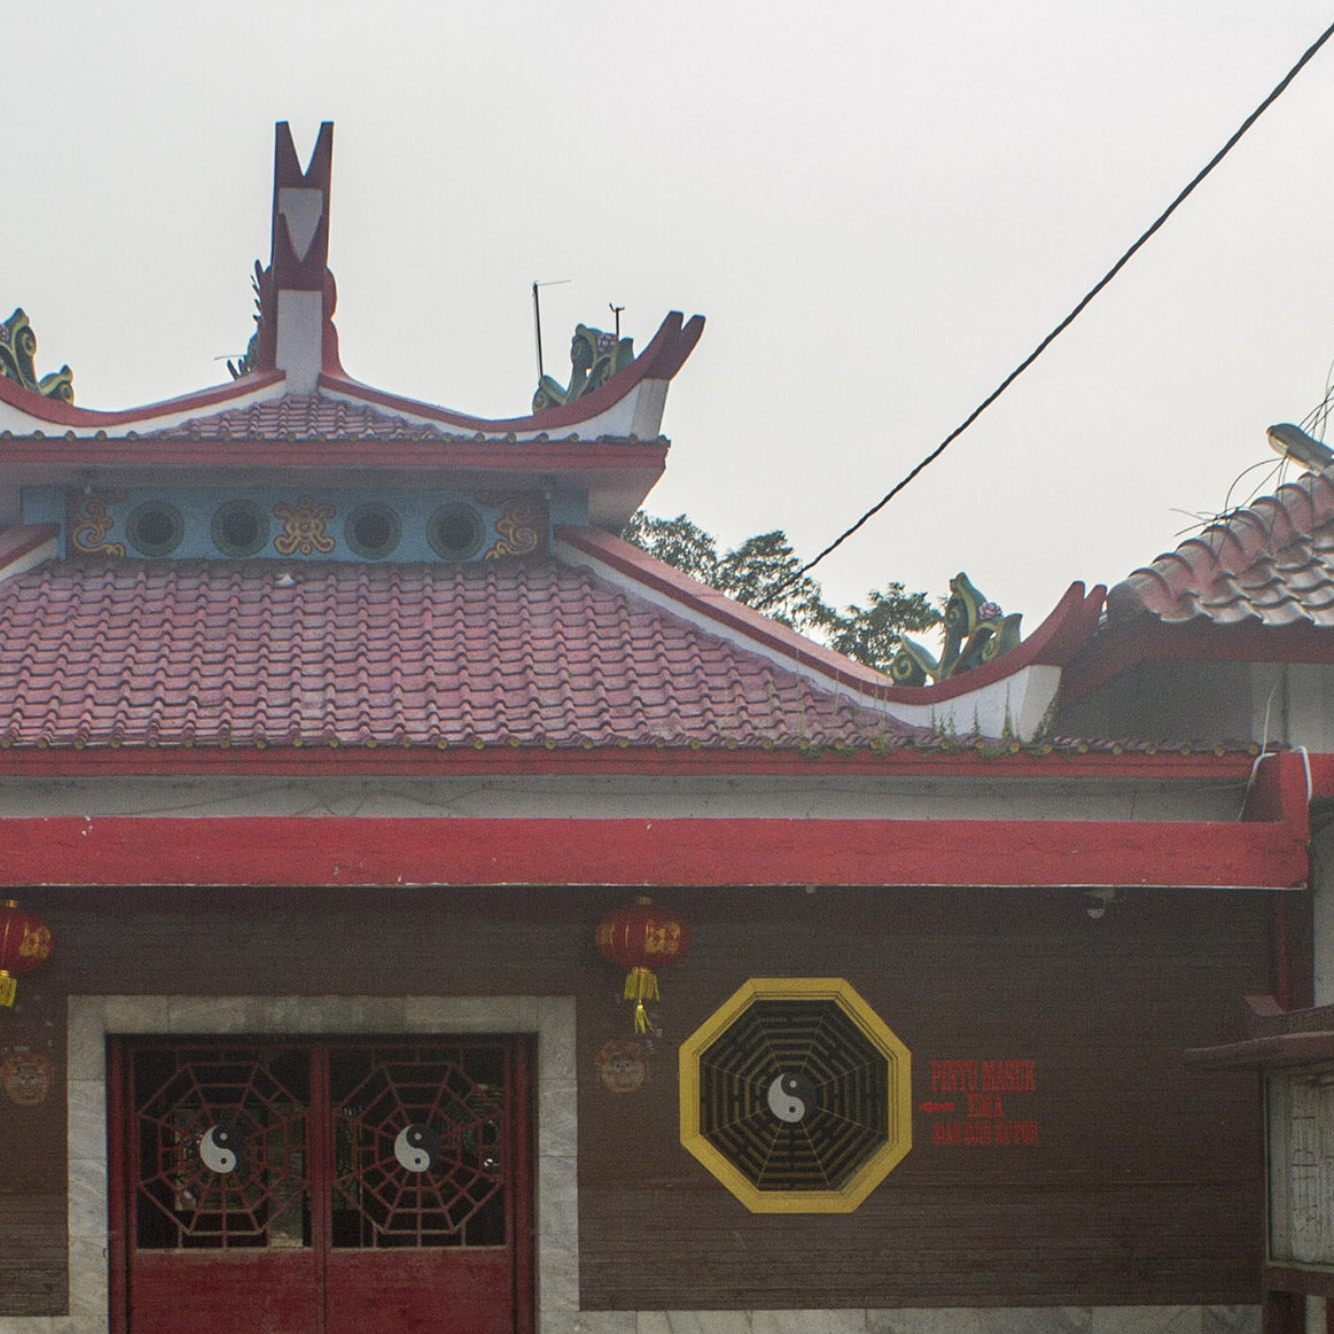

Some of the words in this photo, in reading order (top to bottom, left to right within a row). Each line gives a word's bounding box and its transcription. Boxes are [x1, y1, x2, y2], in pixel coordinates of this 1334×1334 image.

[931, 1060, 977, 1092] PINTU
[981, 1060, 1036, 1092] MASUK
[967, 1093, 1004, 1118] EMA
